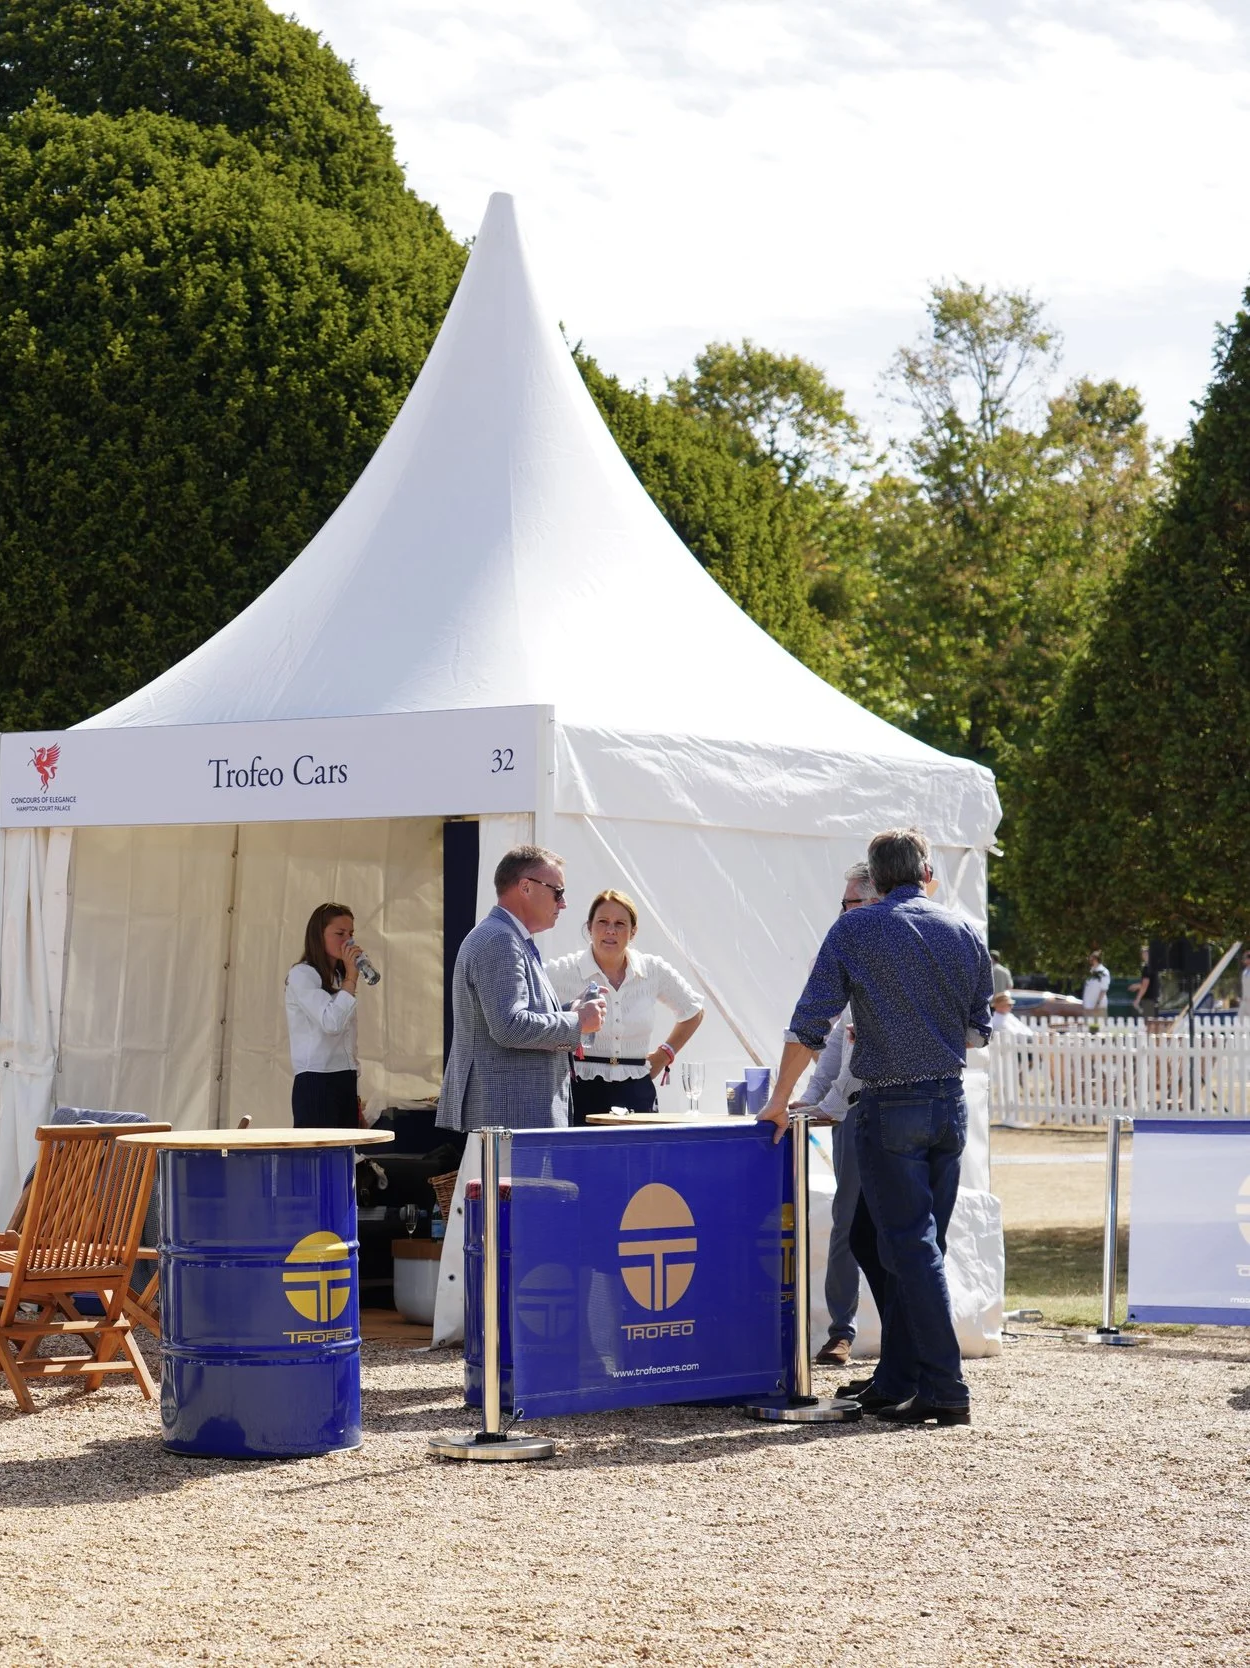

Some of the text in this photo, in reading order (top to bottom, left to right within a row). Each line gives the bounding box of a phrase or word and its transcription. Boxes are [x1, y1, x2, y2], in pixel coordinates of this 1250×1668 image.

[207, 755, 348, 788] Trofeo Cars
[491, 748, 515, 773] 32
[283, 1327, 353, 1344] TROFEO
[621, 1319, 695, 1341] TROFEO
[612, 1362, 700, 1378] www.trofeocars.com
